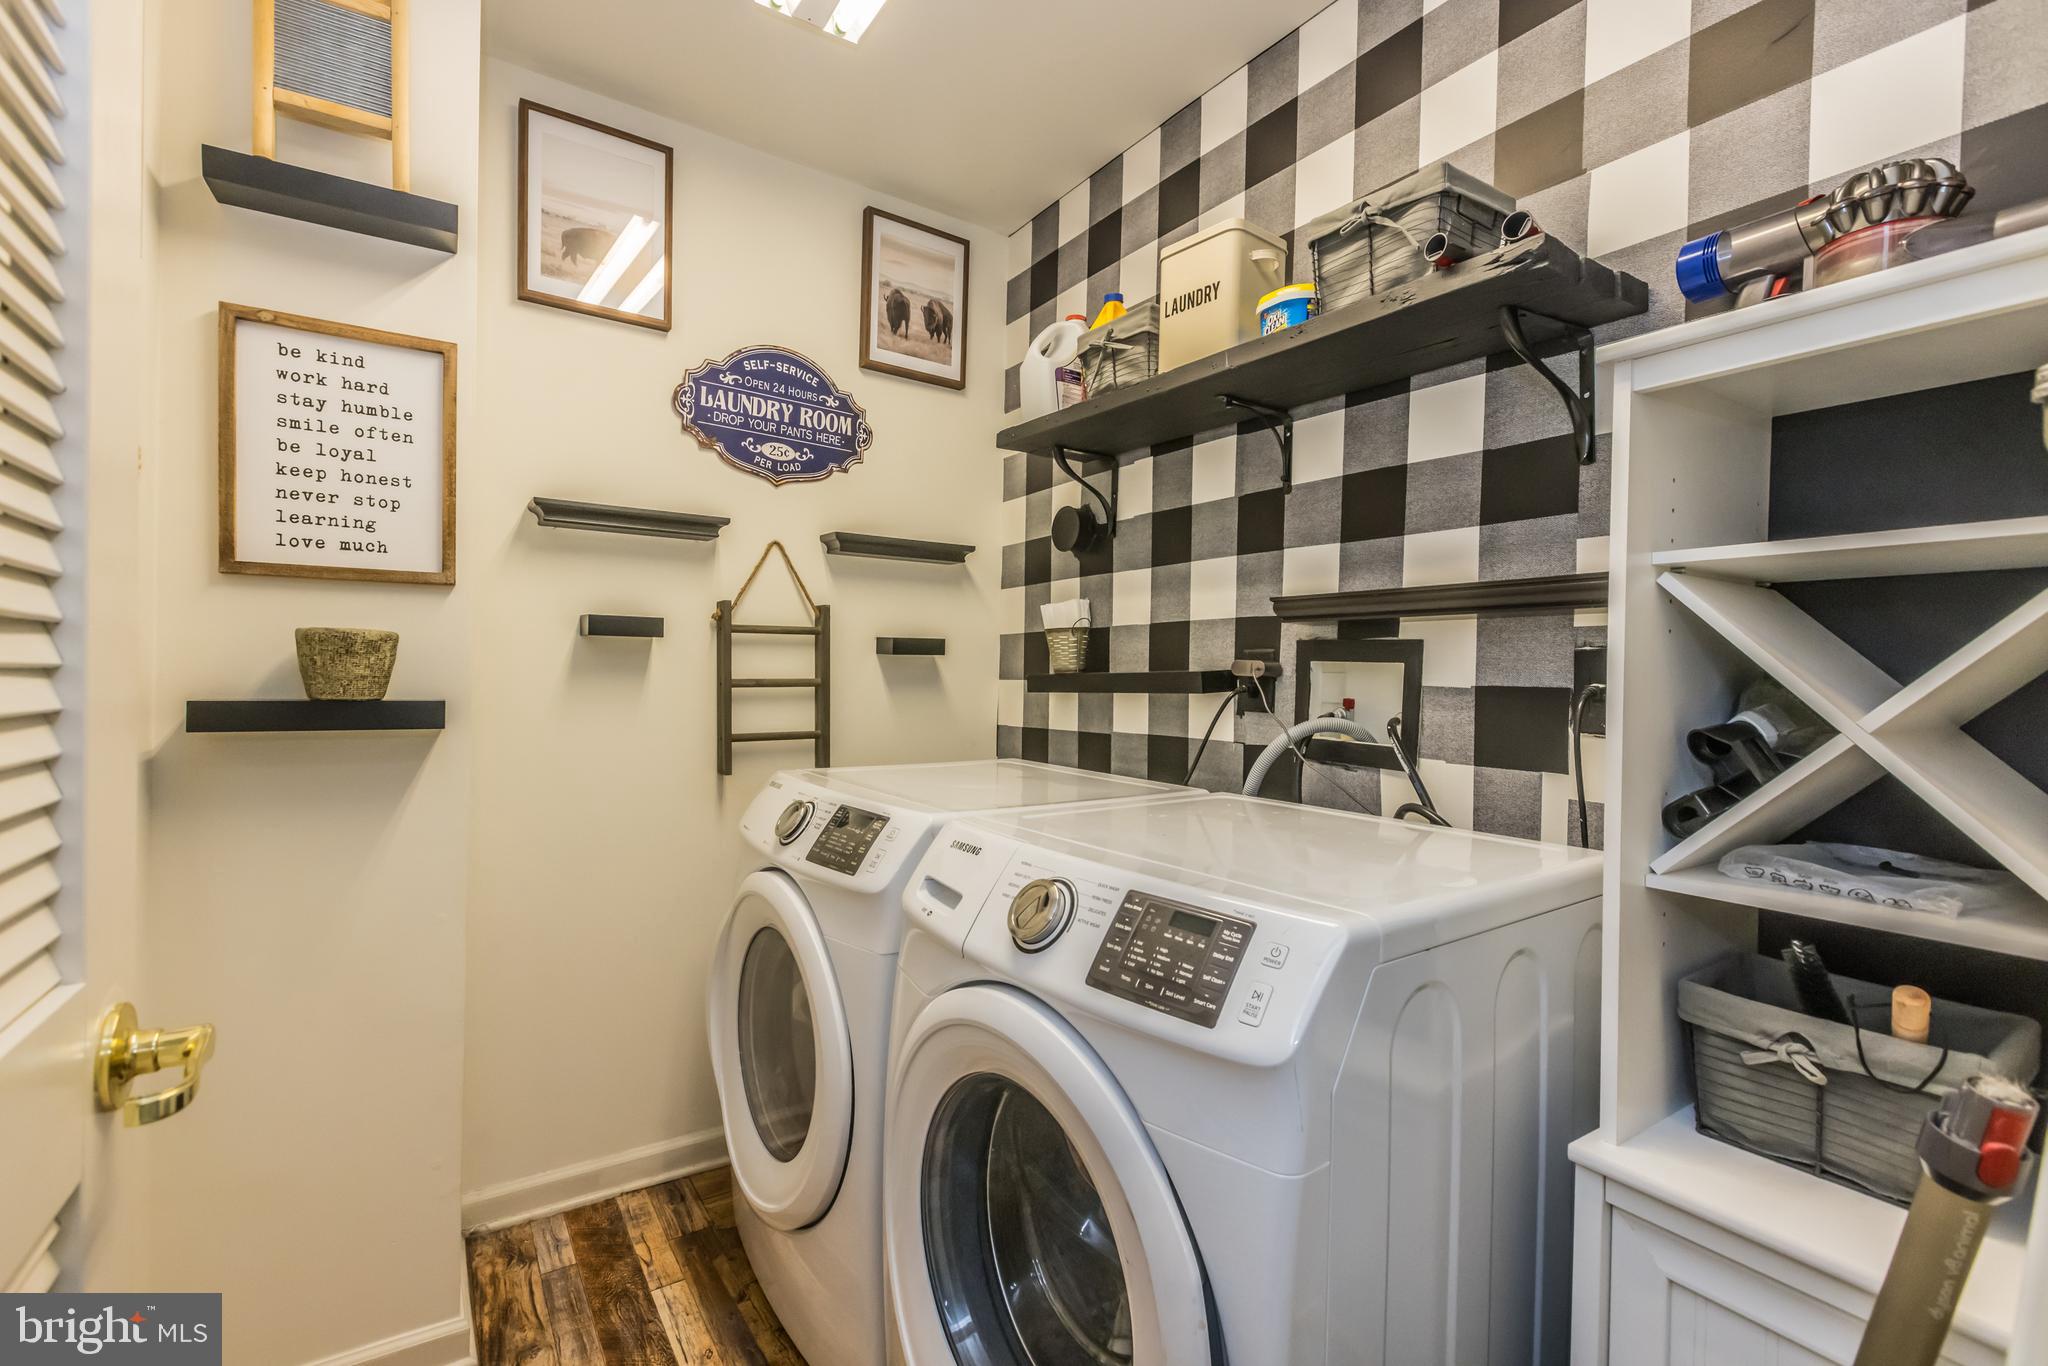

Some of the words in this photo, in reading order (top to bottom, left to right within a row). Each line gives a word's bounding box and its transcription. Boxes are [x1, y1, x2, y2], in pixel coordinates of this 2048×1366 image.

[1165, 281, 1220, 319] LAUNDRY
[277, 343, 301, 358] be
[316, 350, 365, 368] kind
[276, 369, 327, 386] work
[341, 377, 389, 396] hard
[744, 360, 819, 387] SELF-SERVICE
[744, 377, 770, 391] OPEN
[774, 384, 785, 394] 24
[788, 386, 818, 401] HOURS
[277, 393, 327, 412] stay
[341, 400, 413, 421] humble
[700, 386, 794, 423] LAUNDRY
[800, 407, 852, 436] ROOM
[277, 417, 339, 434] smile
[355, 427, 414, 444] often
[714, 410, 744, 426] DROP
[748, 419, 777, 433] YOUR
[781, 425, 812, 440] PANTS
[816, 433, 841, 446] HERE
[277, 438, 300, 452] be
[316, 443, 376, 462] loyal
[769, 444, 790, 457] 25¢
[276, 462, 327, 482] keep
[340, 469, 412, 488] honest
[754, 456, 772, 470] PER
[778, 459, 801, 471] LOAD
[276, 488, 339, 504] never
[354, 495, 401, 512] stop
[276, 510, 376, 533] learning
[276, 533, 325, 549] love
[340, 541, 388, 553] much
[950, 840, 982, 856] SAMSUNG
[1264, 956, 1281, 965] POWER
[1174, 993, 1186, 1001] Level
[1194, 998, 1206, 1007] Smart
[1206, 1002, 1216, 1010] Care
[1246, 1002, 1261, 1010] START
